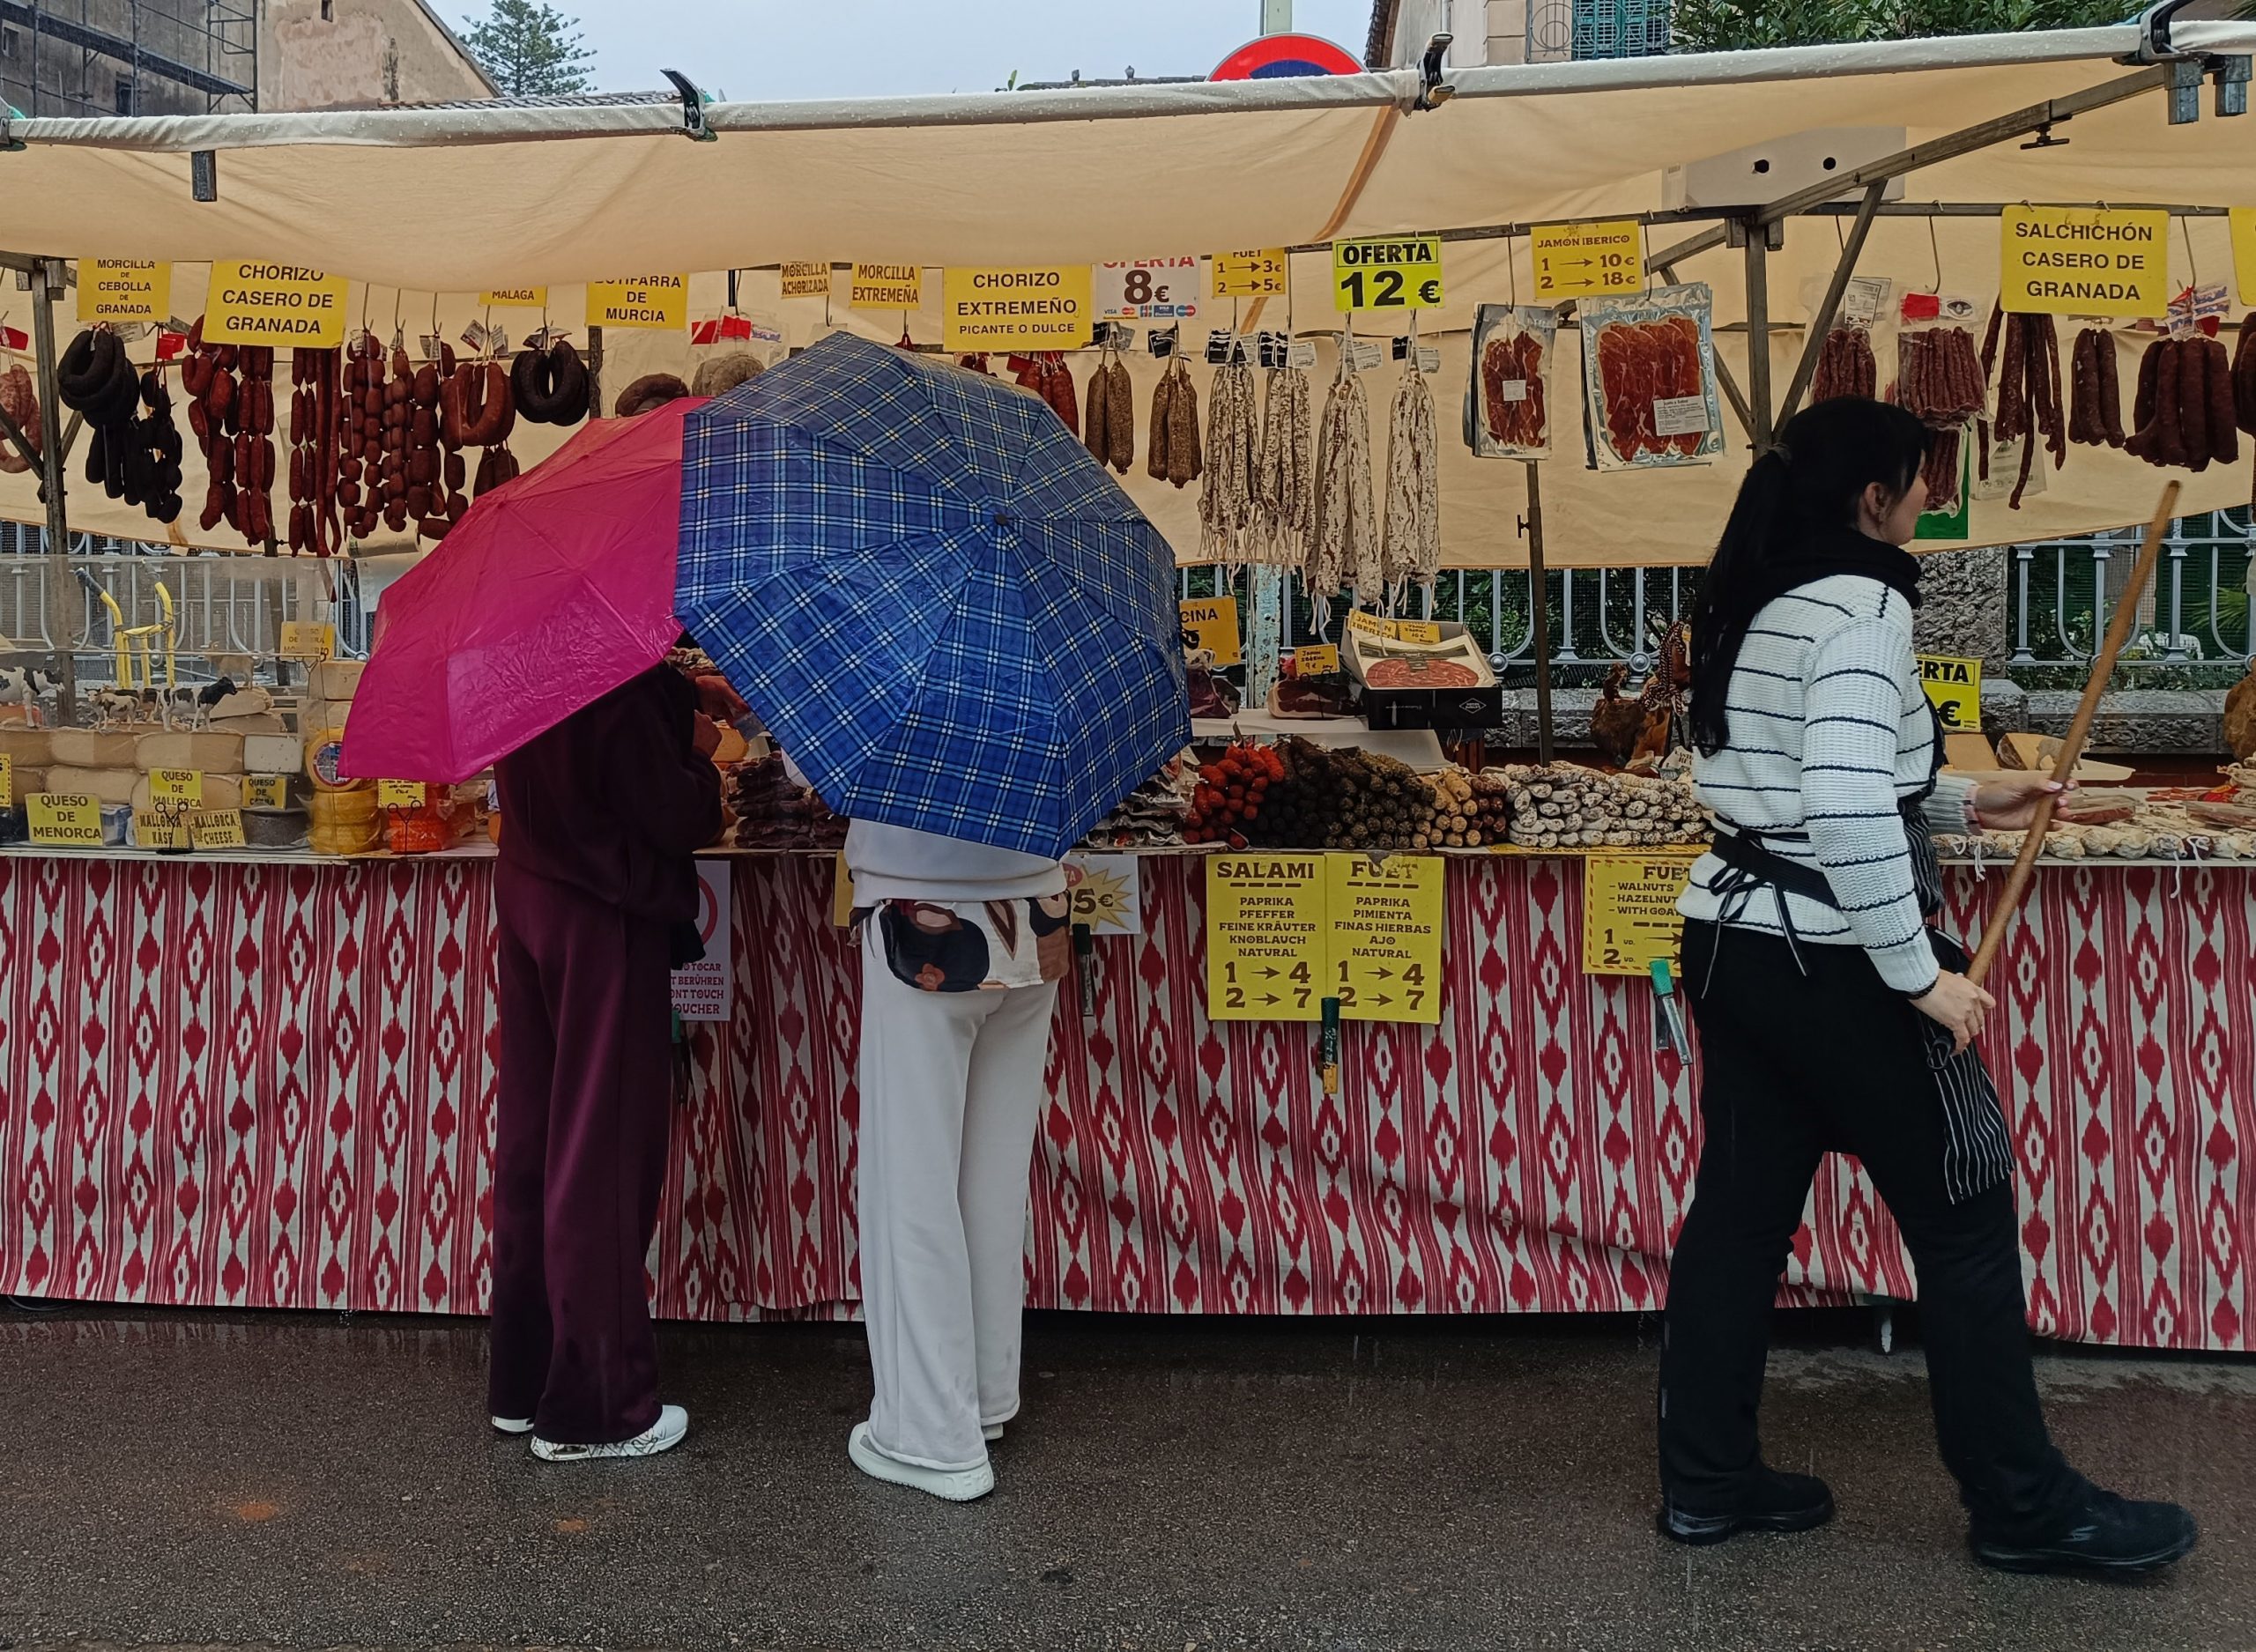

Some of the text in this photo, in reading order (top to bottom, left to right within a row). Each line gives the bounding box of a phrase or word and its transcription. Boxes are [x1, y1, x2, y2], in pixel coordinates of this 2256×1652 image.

[2015, 222, 2152, 241] SALCHICHÓN
[1583, 235, 1629, 246] IBERICO
[1342, 243, 1432, 265] OFERTA
[97, 259, 155, 269] MORCILLA
[1542, 257, 1549, 270] 1
[2022, 252, 2144, 270] CASERO DE
[238, 264, 323, 282] CHORIZO
[782, 263, 827, 278] MORCILLA
[858, 264, 916, 280] MORCILLA
[1218, 263, 1226, 273] 1
[973, 271, 1060, 288] CHORIZO
[1540, 276, 1554, 289] 2
[98, 281, 152, 292] CEBOLLA
[782, 278, 829, 295] ACHORIZADA
[1218, 282, 1227, 293] 2
[1340, 270, 1441, 307] 12 €
[2027, 281, 2141, 300] GRANADA
[222, 290, 333, 308] CASERO DE
[627, 291, 646, 303] DE
[852, 284, 919, 303] EXTREMEÑA
[96, 304, 152, 314] GRANADA
[957, 297, 1077, 316] EXTREMEÑO
[605, 307, 665, 322] MURCIA
[226, 315, 322, 334] GRANADA
[960, 323, 1075, 335] PICANTE O DULCE
[1355, 616, 1391, 632] JAMN
[161, 771, 193, 782] QUESO
[249, 779, 275, 788] QUESO
[41, 795, 88, 807] QUESO
[57, 811, 75, 822] DE
[140, 815, 182, 827] MALLORA
[194, 814, 236, 828] MALLORCA
[33, 826, 101, 839] MENORCA
[204, 832, 234, 844] CHEESE
[1217, 862, 1314, 879] SALAMI
[1617, 882, 1674, 892] WALNUTS
[1240, 897, 1294, 906] PAPRIKA
[1355, 897, 1410, 907] PAPRIKA
[1353, 909, 1413, 921] PIMIENTA
[1617, 906, 1647, 915] WITH
[1220, 921, 1316, 931] FEINE KRÄUTER
[1334, 921, 1431, 934] FINAS HIERBAS
[1229, 935, 1306, 944] KNOBLAUCH
[1604, 928, 1614, 945] 1
[1238, 948, 1297, 957] NATURAL
[1352, 948, 1412, 959] NATURAL
[1603, 948, 1621, 965] 2
[1225, 961, 1311, 983] 1 4
[1338, 960, 1425, 986] 1 4
[690, 989, 724, 999] TOUCH
[1226, 988, 1312, 1008] 2 7
[1338, 986, 1425, 1011] 2 7
[672, 1004, 720, 1014] OUCHER
